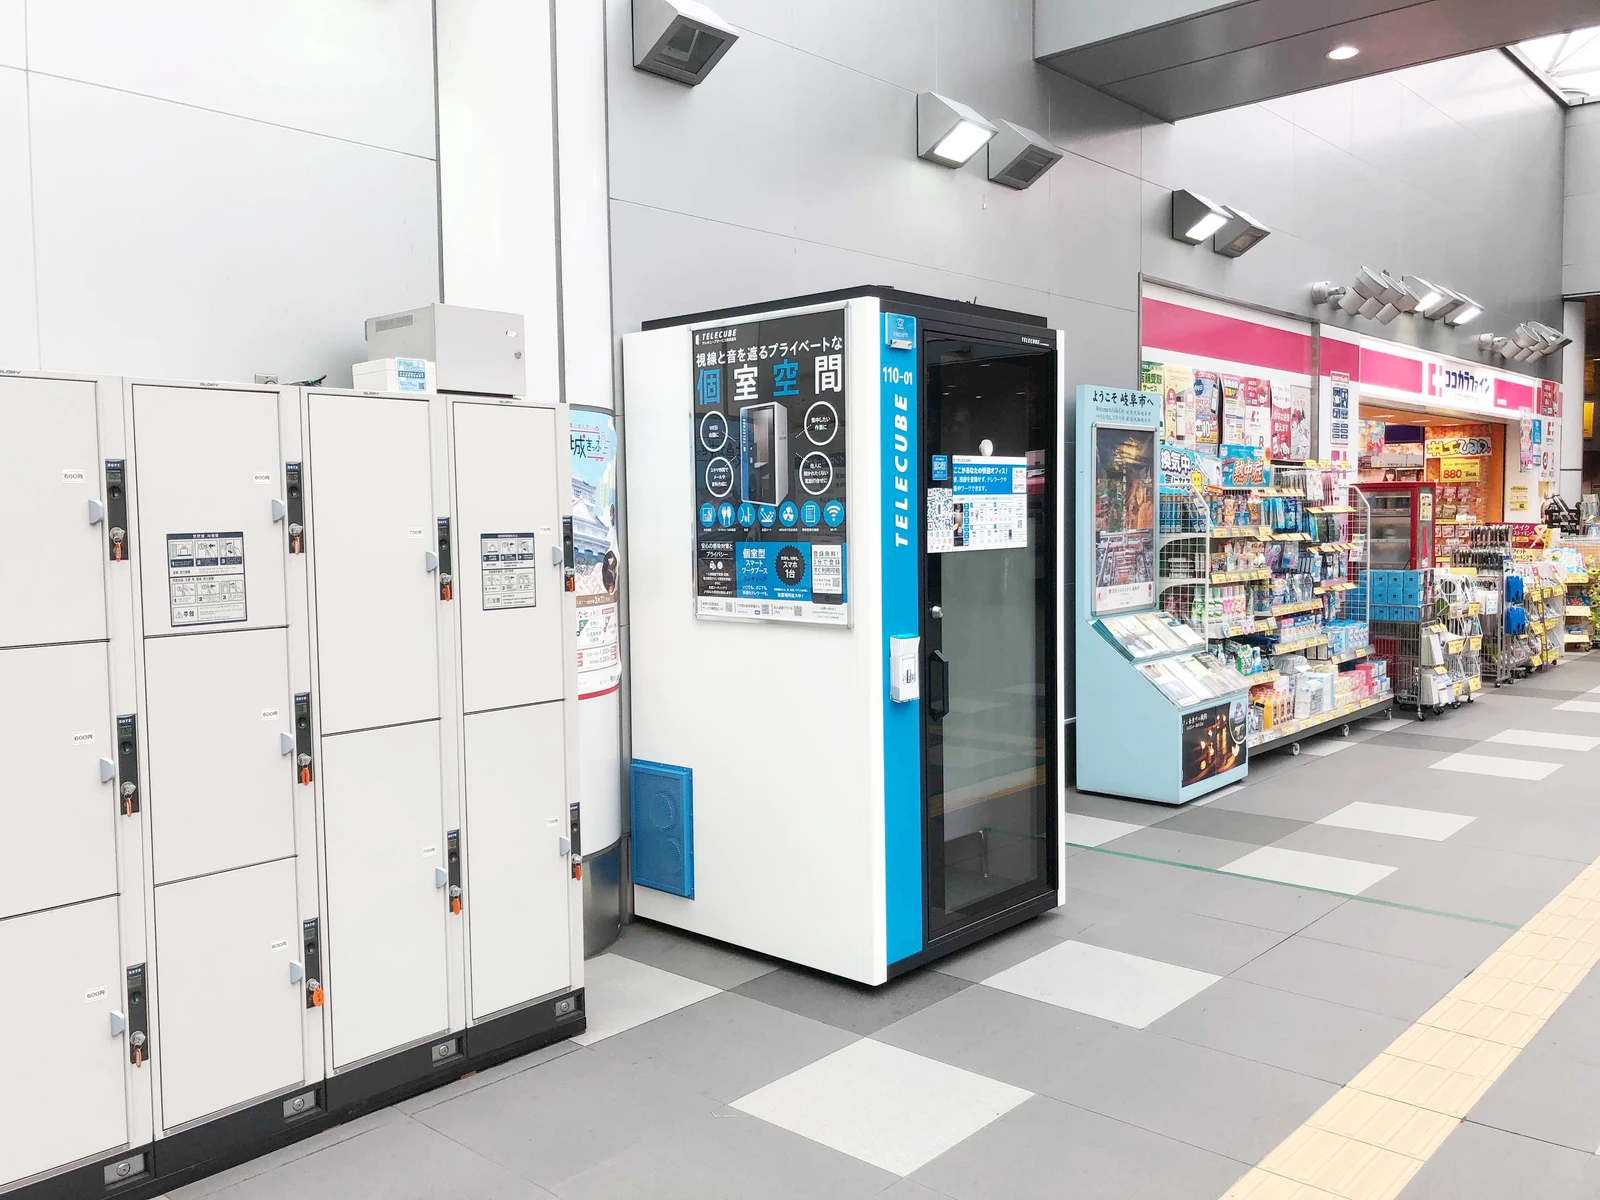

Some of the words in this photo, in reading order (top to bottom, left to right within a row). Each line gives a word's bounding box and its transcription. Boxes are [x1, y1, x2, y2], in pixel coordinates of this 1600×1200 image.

[702, 328, 737, 341] TELECUBE
[696, 335, 843, 369] 視線と音を遮るプライベートな
[696, 353, 842, 406] 個室空間
[882, 366, 913, 386] 110-01
[1445, 370, 1490, 394] ココカラファイン
[1092, 390, 1118, 404] ようこそ
[1120, 391, 1154, 408] 岐阜市へ
[894, 394, 909, 548] TELECUBE
[1443, 469, 1462, 479] 880
[743, 548, 766, 559] 個室型
[745, 559, 764, 567] スマート
[782, 561, 799, 569] スマホ
[741, 567, 769, 575] ワークブース
[784, 569, 796, 579] 1台
[86, 990, 105, 999] 600円
